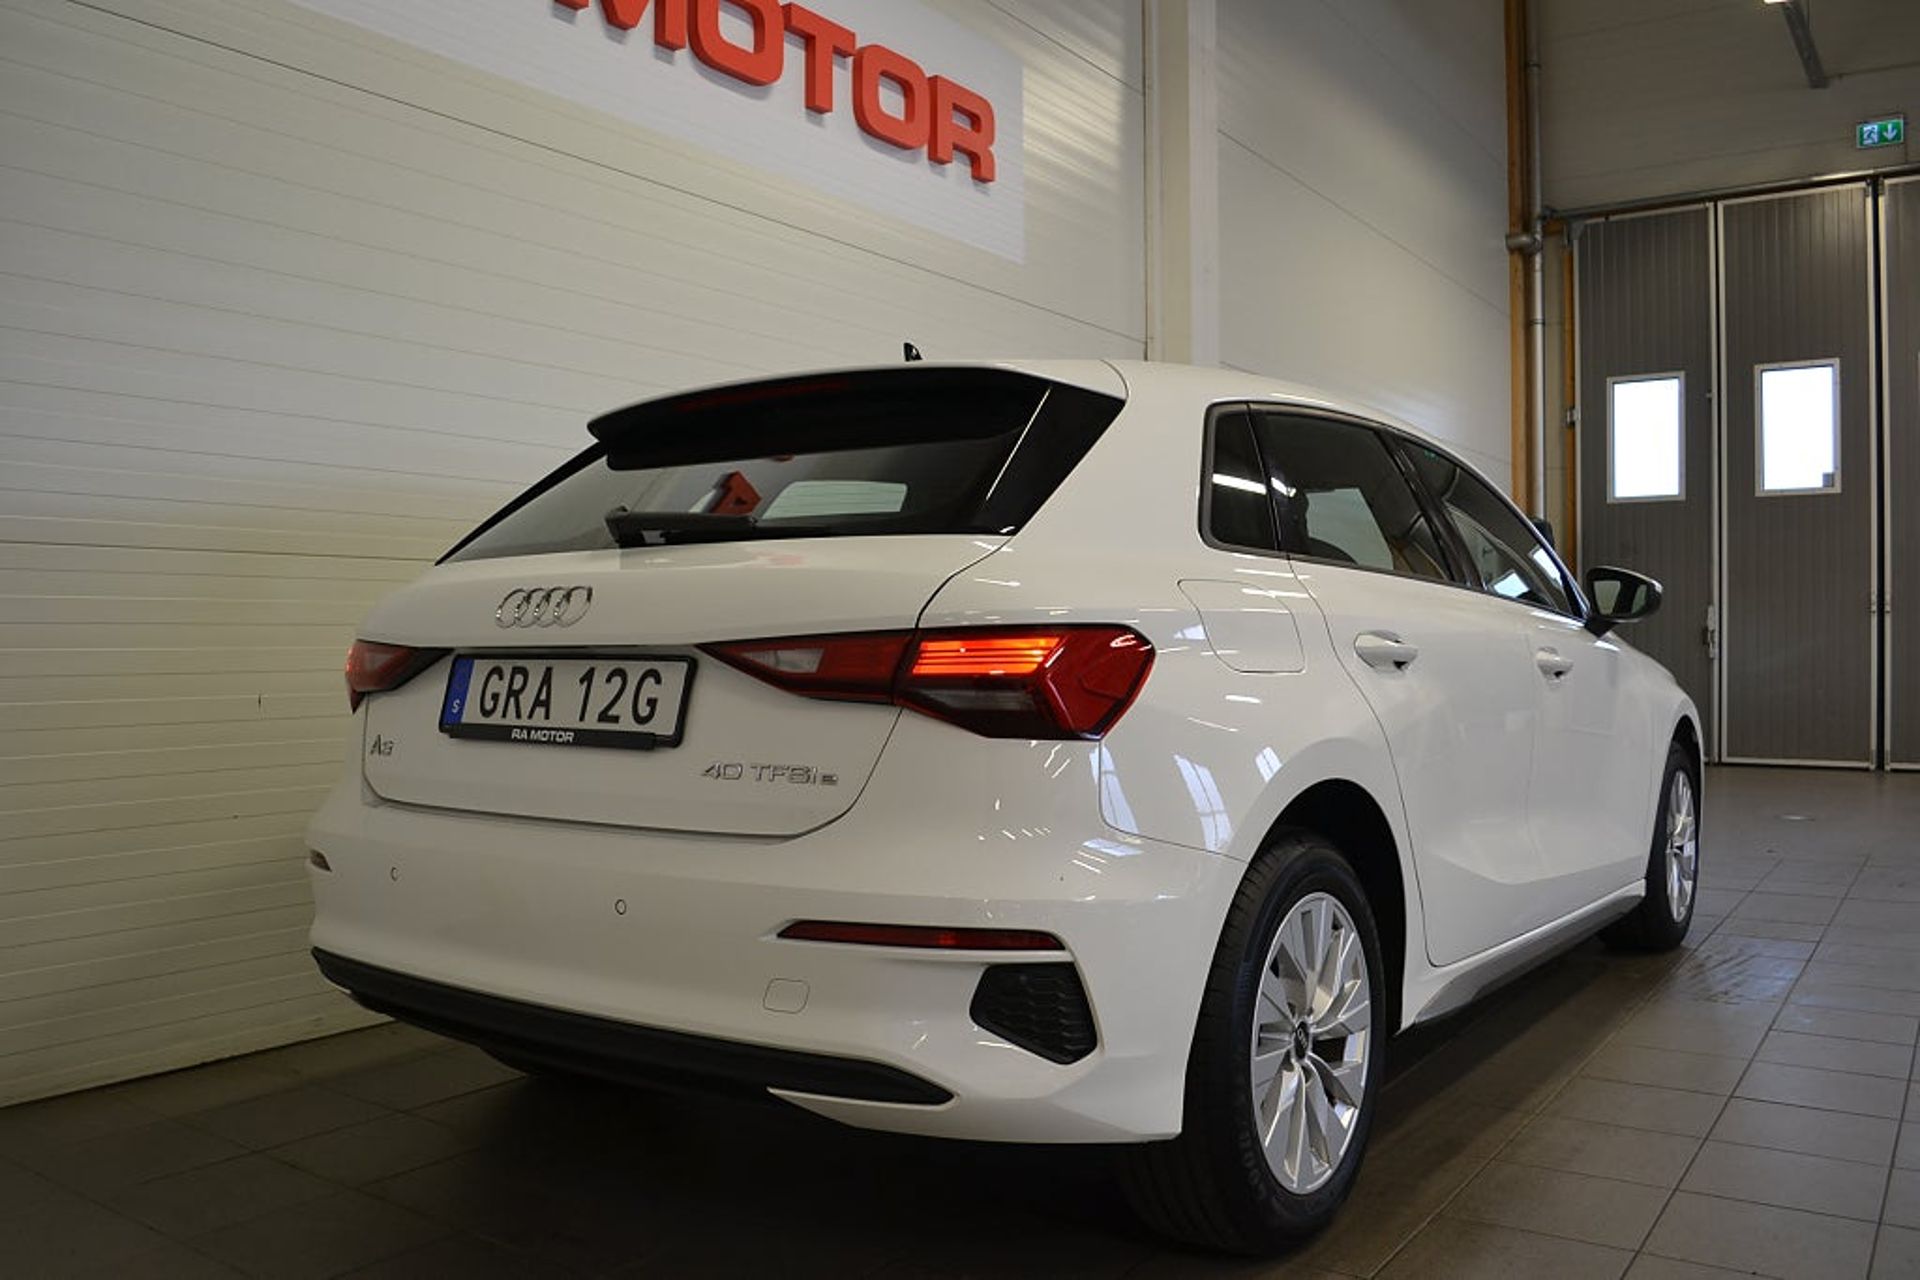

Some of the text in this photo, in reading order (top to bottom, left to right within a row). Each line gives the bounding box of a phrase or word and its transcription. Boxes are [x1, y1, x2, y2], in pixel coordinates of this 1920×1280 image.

[480, 665, 663, 726] GRA 12G
[451, 699, 461, 714] S
[511, 729, 574, 743] RA MOTOR
[702, 763, 743, 781] 40
